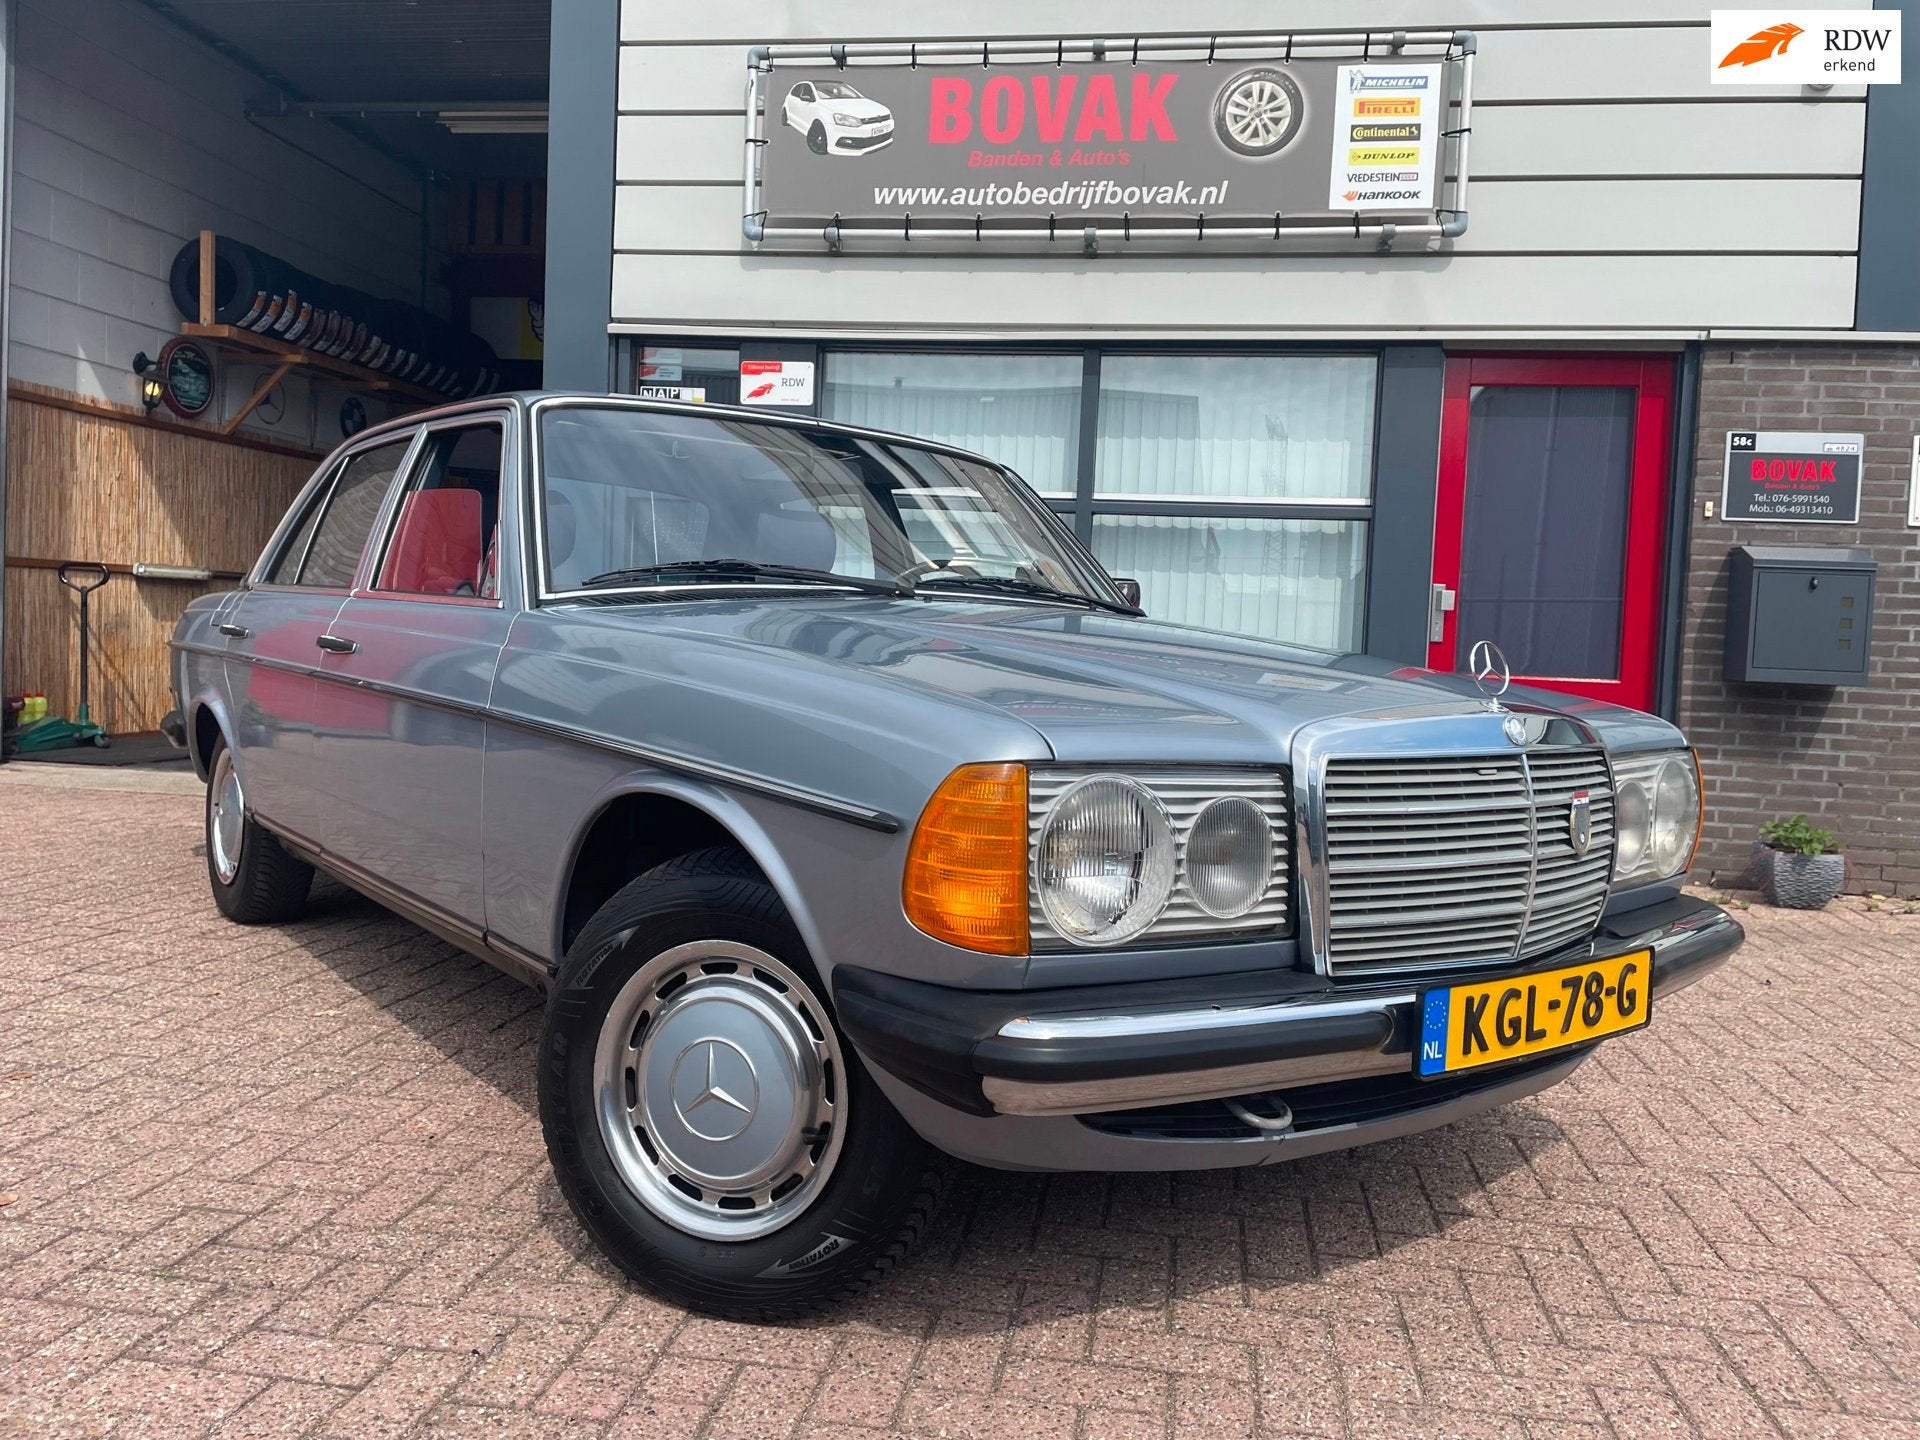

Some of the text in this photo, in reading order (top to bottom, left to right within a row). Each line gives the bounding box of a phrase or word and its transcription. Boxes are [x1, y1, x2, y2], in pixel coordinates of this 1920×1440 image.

[1364, 77, 1426, 87] MICHELIN
[928, 74, 1180, 144] BOVAK
[1358, 100, 1416, 114] PIRELLI
[1352, 126, 1410, 139] Continental
[967, 149, 1132, 168] Banden & Auto's
[1347, 172, 1400, 183] VREDESTEIN
[873, 180, 1229, 210] www.autobedrijfbovak.nl
[781, 377, 805, 387] RDW
[1733, 436, 1753, 446] 58c
[1751, 458, 1837, 482] BOVAK
[1754, 493, 1830, 503] Tel.: 076-5991540
[1749, 504, 1834, 514] Mob.: 06-49313410
[1462, 963, 1638, 1056] KGL-78-G
[1423, 1040, 1443, 1061] NL
